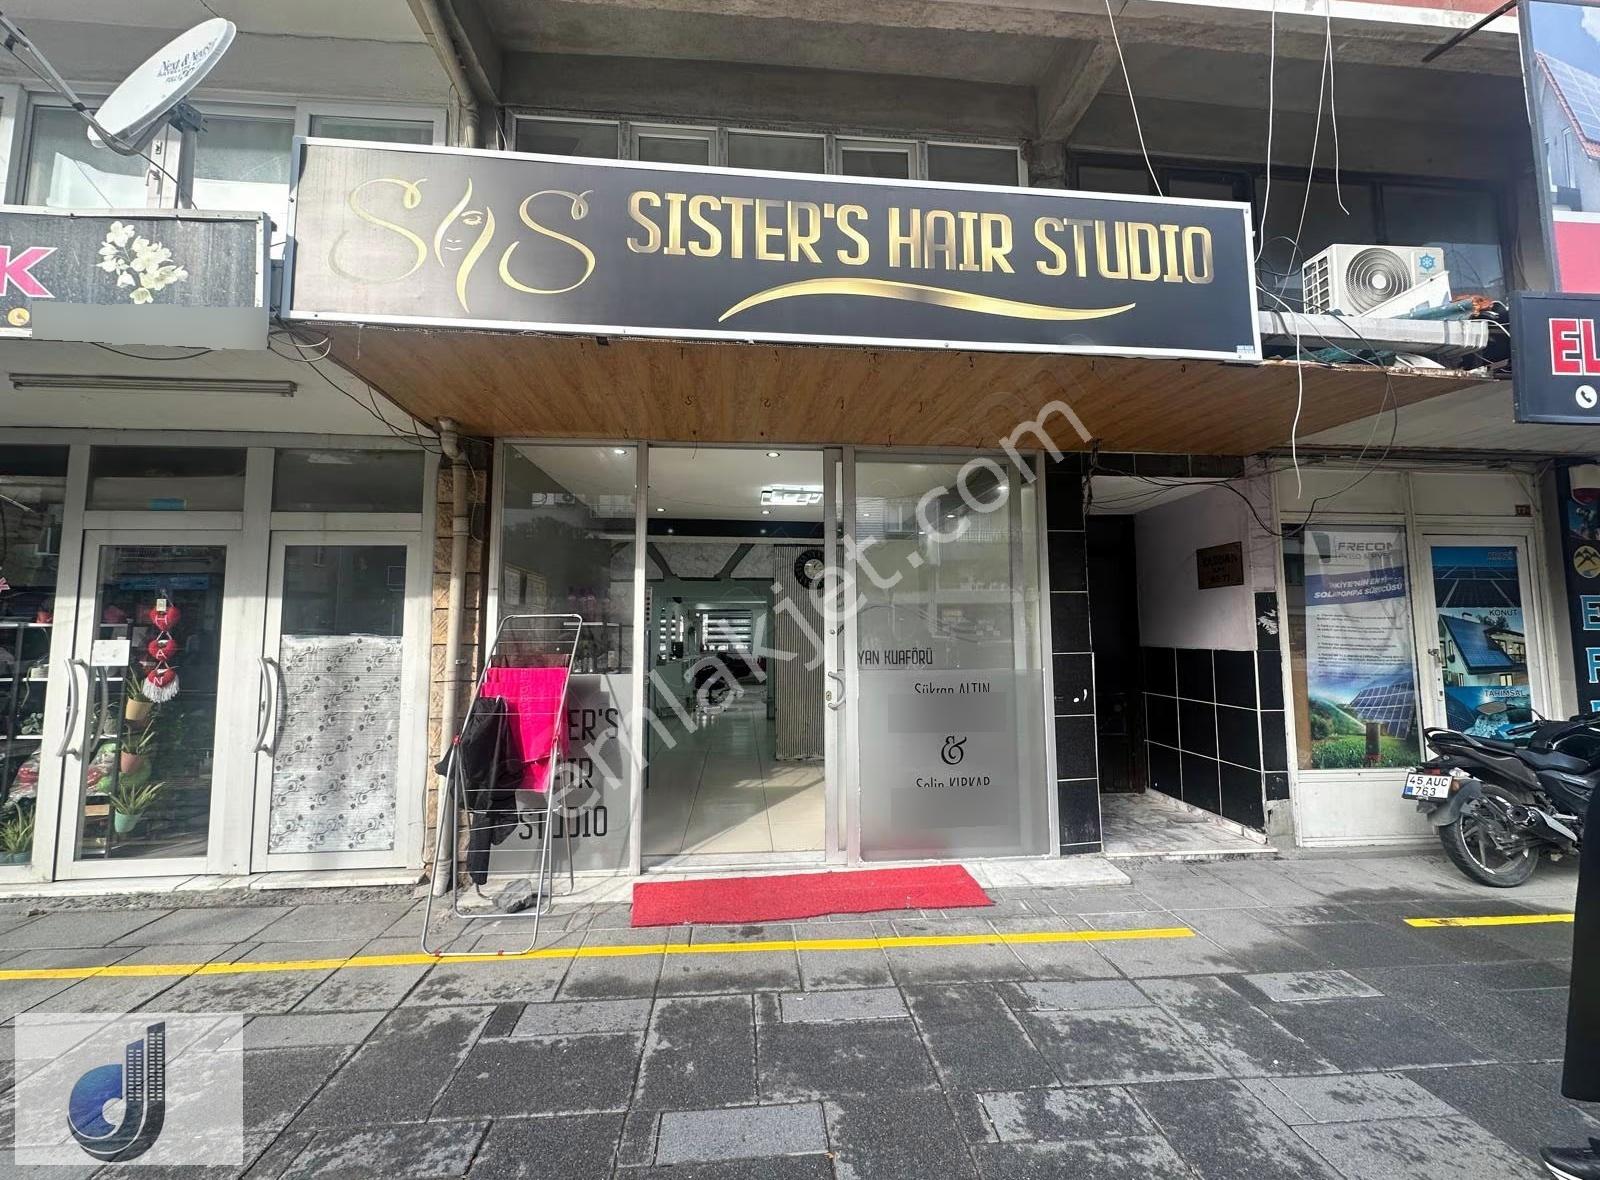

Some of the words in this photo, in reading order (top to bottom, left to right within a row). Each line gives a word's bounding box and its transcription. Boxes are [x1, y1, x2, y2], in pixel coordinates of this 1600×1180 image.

[626, 191, 870, 265] SISTER'S
[888, 207, 1015, 273] HAIR
[1034, 216, 1214, 285] STUDIO
[1489, 609, 1518, 617] KONUT
[884, 647, 933, 665] KUAFÖRÜ
[941, 735, 967, 765] &
[1409, 776, 1424, 785] 45
[1425, 777, 1448, 787] AUC
[1415, 786, 1437, 797] 763
